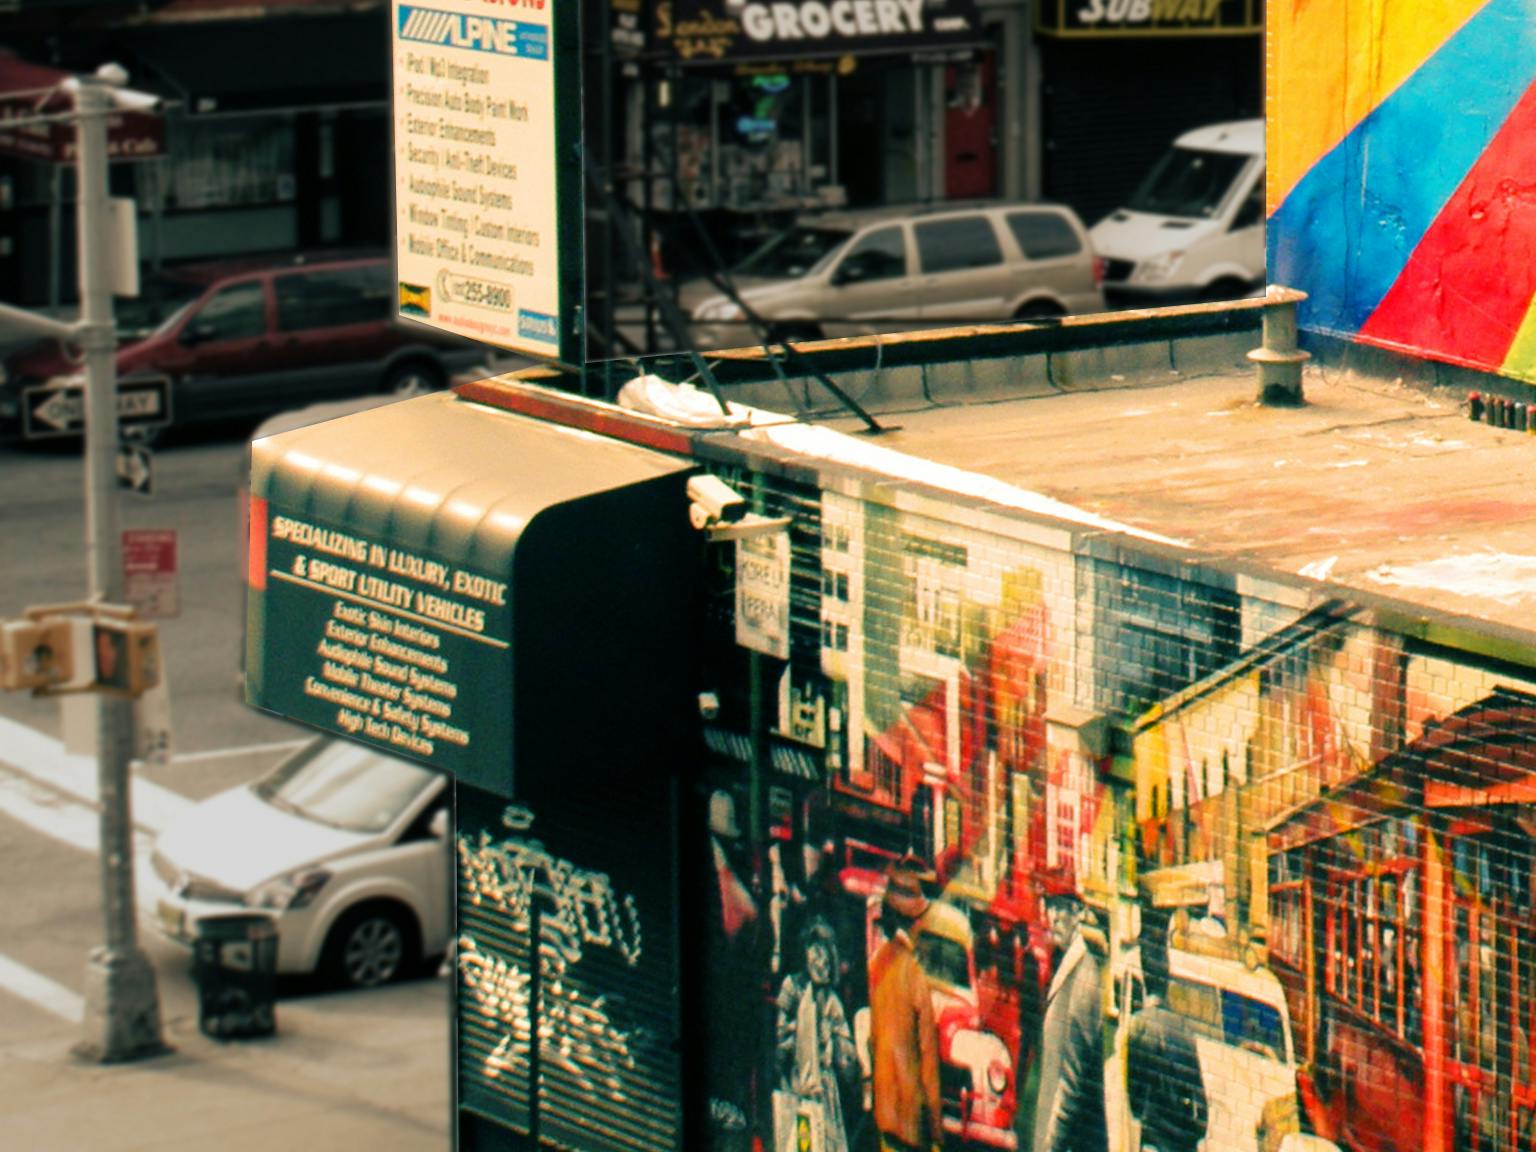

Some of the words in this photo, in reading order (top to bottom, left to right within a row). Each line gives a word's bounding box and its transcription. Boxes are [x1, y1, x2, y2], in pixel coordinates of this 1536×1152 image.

[271, 515, 369, 563] SPECIALIZING
[369, 543, 388, 568] IN
[388, 549, 451, 591] LUXURY,
[452, 569, 508, 606] EXOTIC
[292, 554, 307, 577] &
[308, 559, 358, 591] SPORT
[357, 574, 415, 609] UTILITY
[415, 591, 486, 632] VEHICLES
[324, 619, 369, 648] Exterior
[368, 633, 448, 674] Enhancements
[332, 600, 368, 626] Exotic
[367, 610, 393, 634] Skin
[392, 619, 440, 649] Interiors
[316, 638, 373, 670] Audiophile
[374, 655, 408, 683] Sound
[408, 666, 458, 698] Systems
[322, 660, 360, 688] Mobile
[359, 672, 402, 700] Theater
[402, 687, 451, 719] Systems
[304, 676, 372, 713] Convenience
[382, 701, 420, 733] Safety
[420, 714, 471, 746] Systems
[336, 708, 364, 734] High
[363, 715, 391, 740] Tech
[390, 725, 434, 757] Devices
